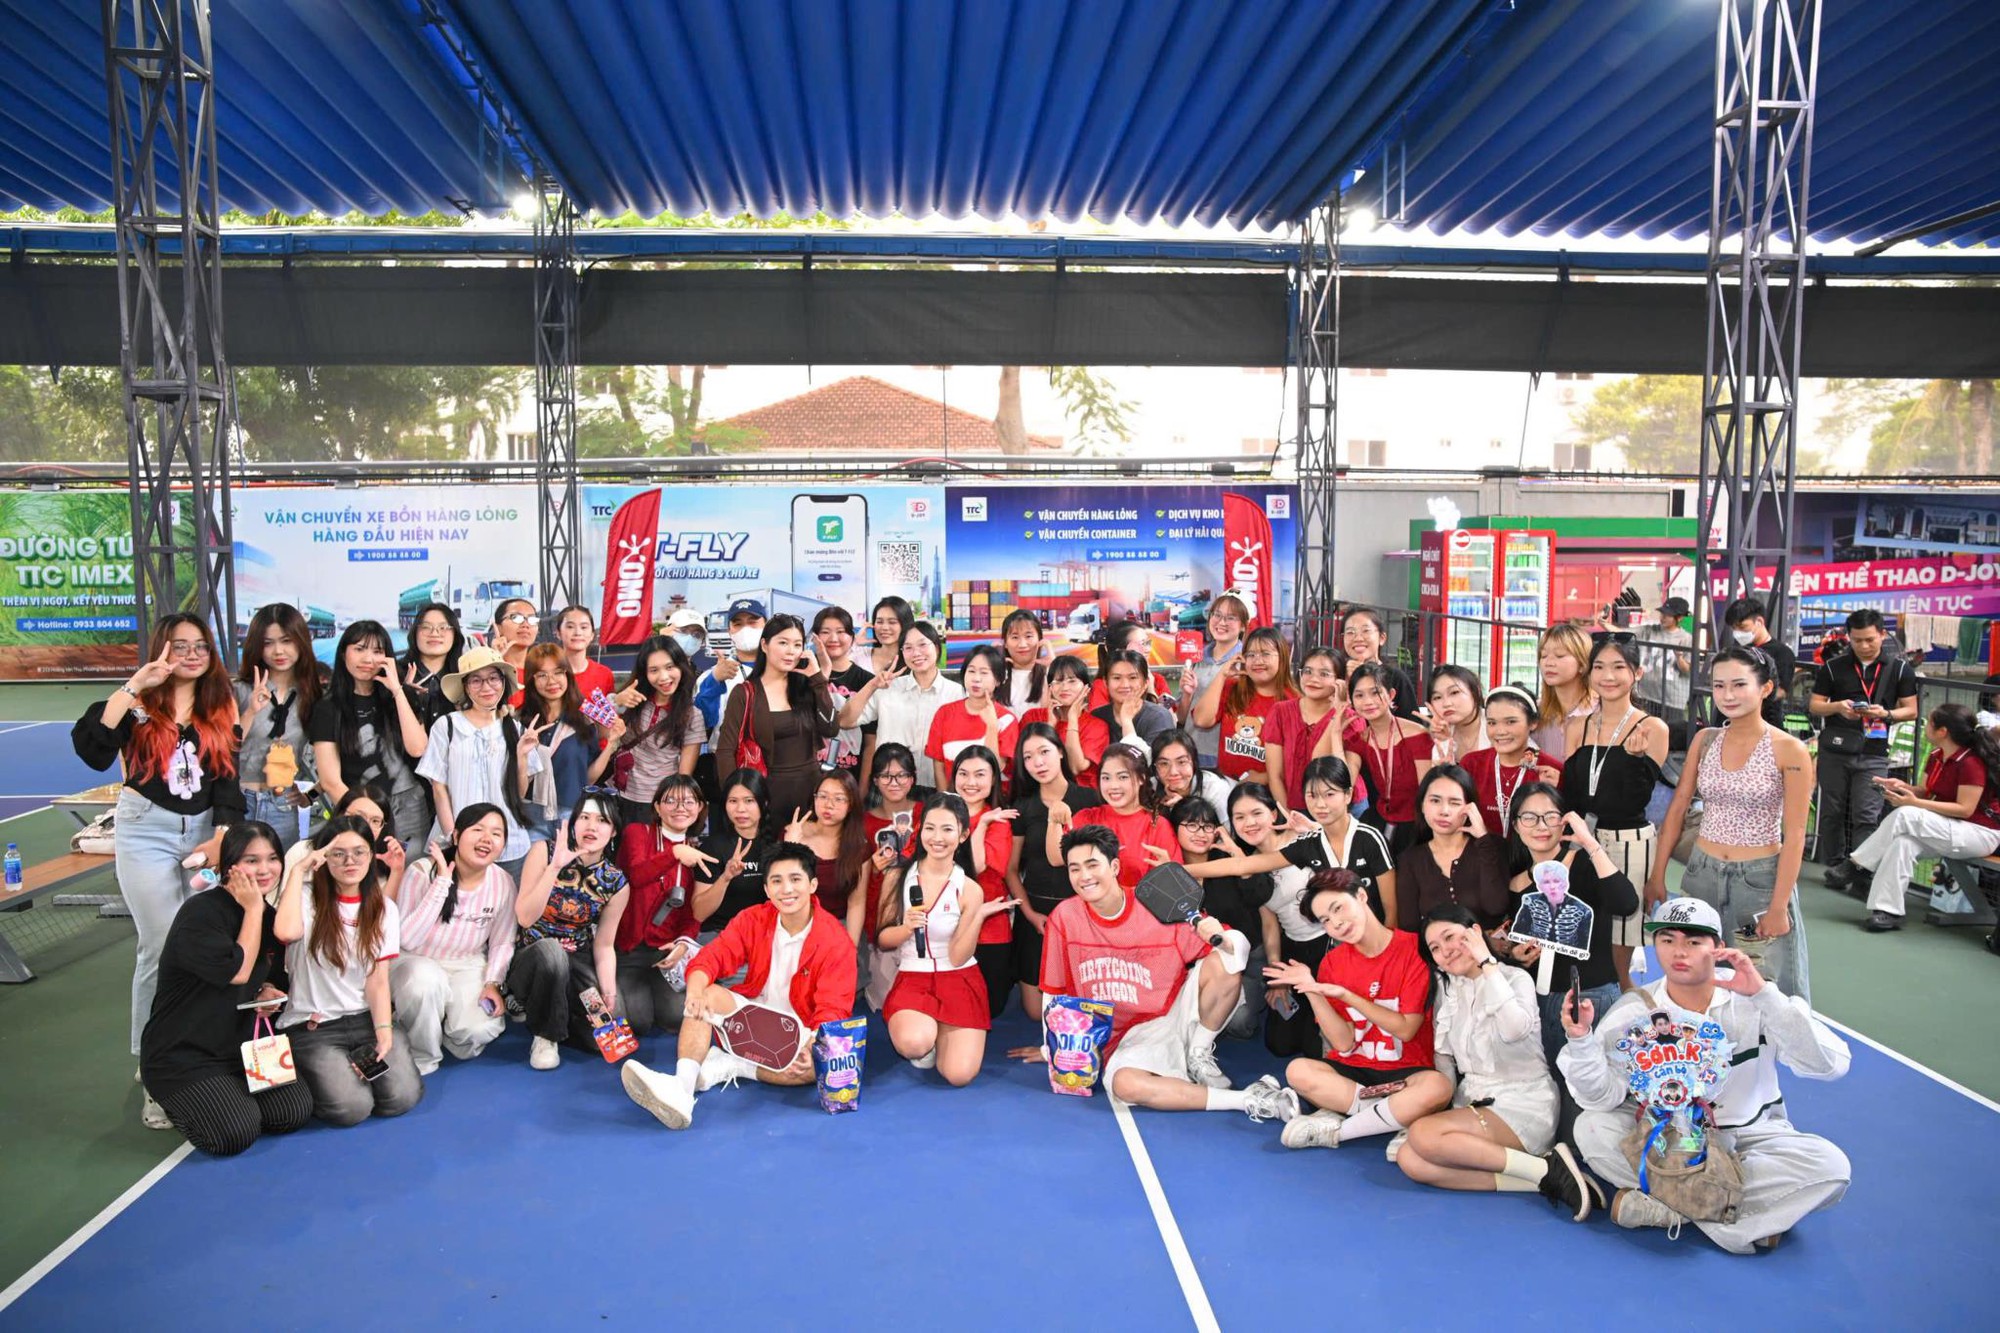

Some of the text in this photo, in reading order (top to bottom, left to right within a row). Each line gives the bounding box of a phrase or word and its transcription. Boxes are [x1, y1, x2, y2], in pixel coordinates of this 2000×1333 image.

[265, 509, 296, 527] VẬN
[301, 505, 361, 523] CHUYỂN
[367, 511, 385, 523] XE
[427, 507, 471, 521] HÀNG
[476, 504, 518, 521] LỎNG
[1038, 507, 1138, 523] VẬN CHUYỂN HÀNG LỎNG
[1168, 509, 1188, 522] DỊCH
[1189, 509, 1201, 522] VỤ
[1202, 509, 1220, 519] KHO
[313, 528, 358, 542] HÀNG
[400, 526, 434, 544] HIỆN
[439, 529, 469, 541] NAY
[1038, 526, 1137, 542] VẬN CHUYỂN CONTAINER
[1168, 529, 1183, 541] ĐẠI
[1195, 526, 1209, 538] HẢI
[0, 533, 98, 558] ĐƯỜNG
[367, 551, 386, 559] 1900
[411, 550, 421, 558] 00
[1105, 551, 1124, 559] 1900
[16, 564, 135, 586] TTC IMEX
[688, 566, 717, 579] HÀNG
[747, 568, 760, 579] XE
[1825, 561, 1869, 588] THỂ
[1873, 566, 1936, 587] THAO
[616, 561, 646, 618] OMO
[1232, 564, 1258, 618] OM
[1889, 594, 1931, 614] LIÊN
[1935, 595, 1973, 615] TỤC
[38, 621, 71, 630] Hotline:
[73, 620, 94, 629] 0933
[1092, 981, 1138, 1006] SAIGON
[1058, 1033, 1092, 1053] OMO
[829, 1054, 857, 1072] OMO
